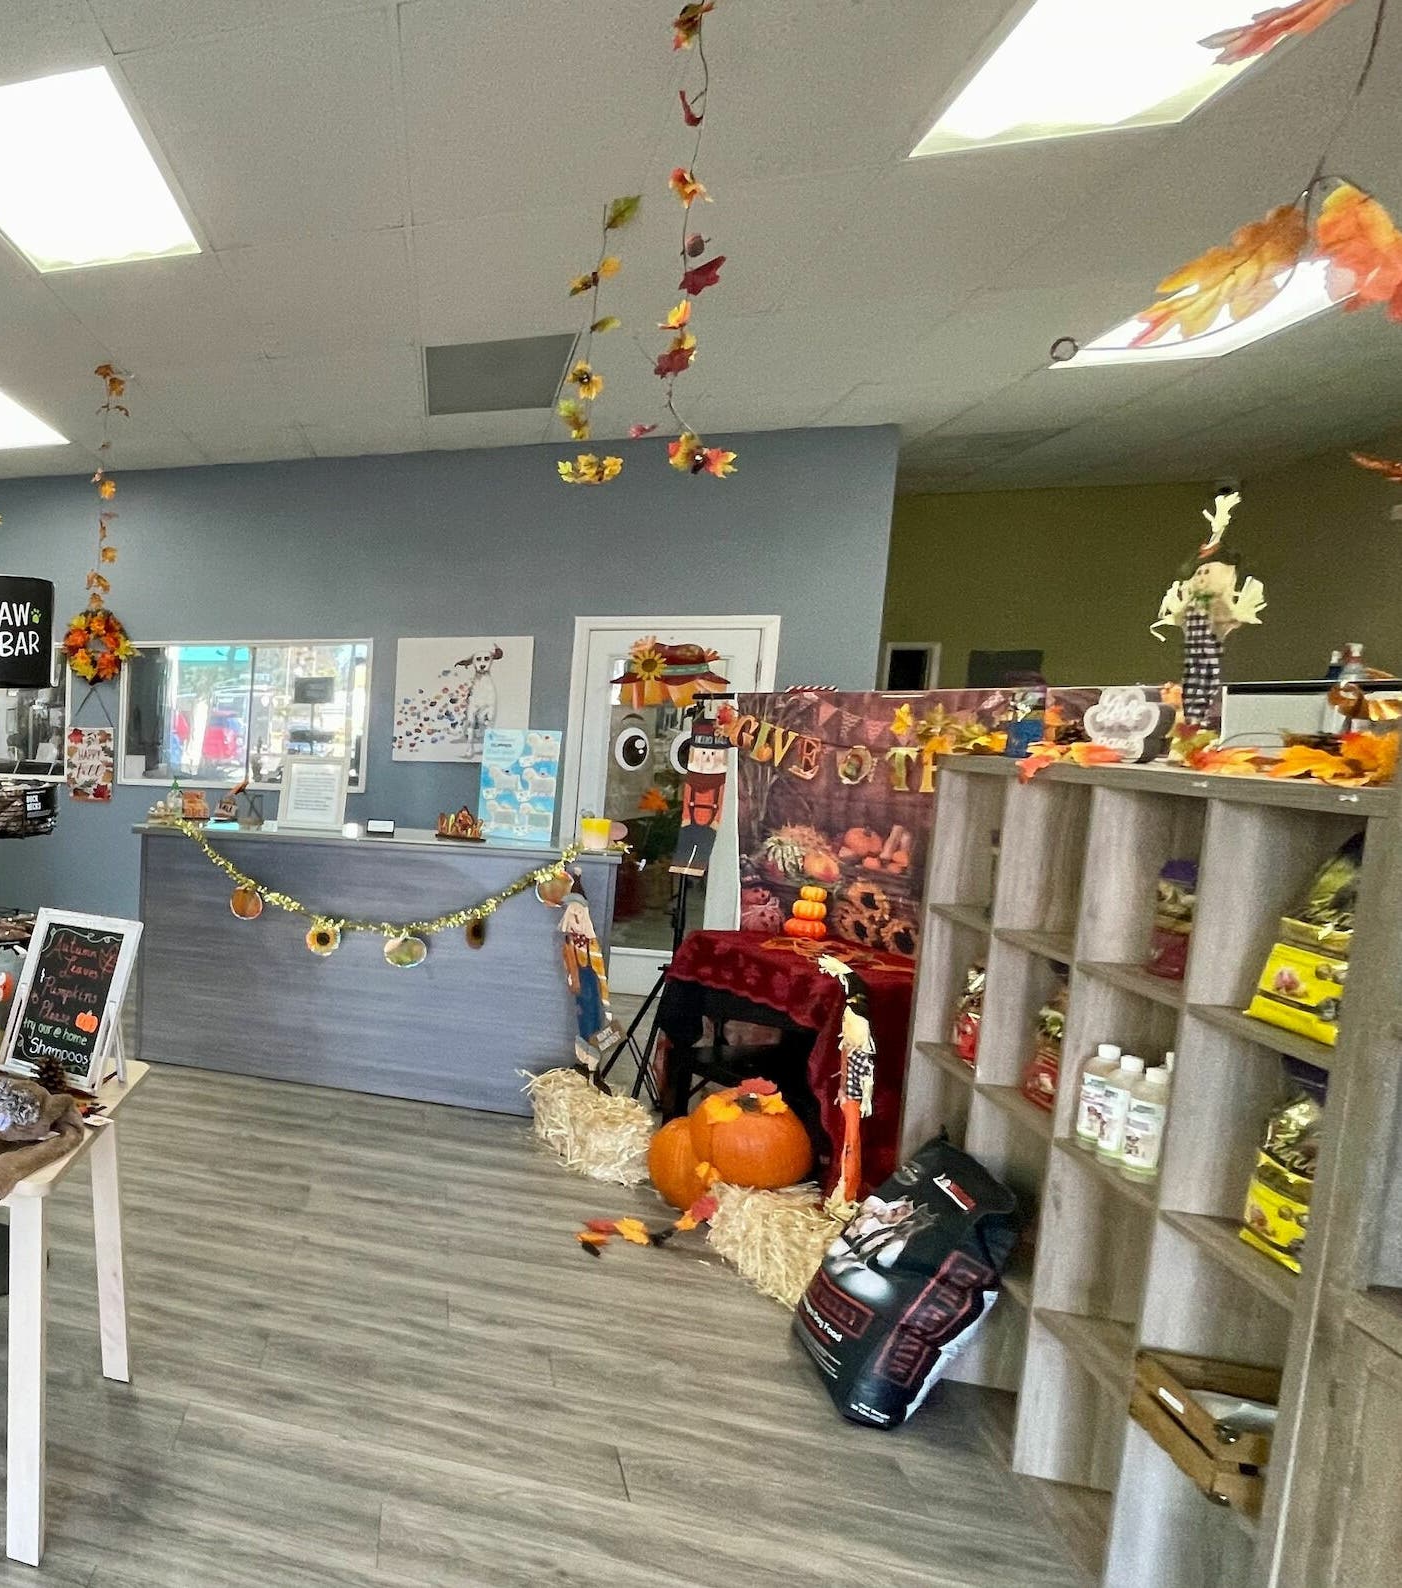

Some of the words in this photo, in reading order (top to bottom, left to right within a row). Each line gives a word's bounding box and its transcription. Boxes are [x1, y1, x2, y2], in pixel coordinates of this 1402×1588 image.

[729, 714, 823, 780] GIVE
[23, 1017, 37, 1039] try
[38, 1023, 54, 1035] our
[62, 1028, 88, 1046] home
[823, 1321, 843, 1343] Food
